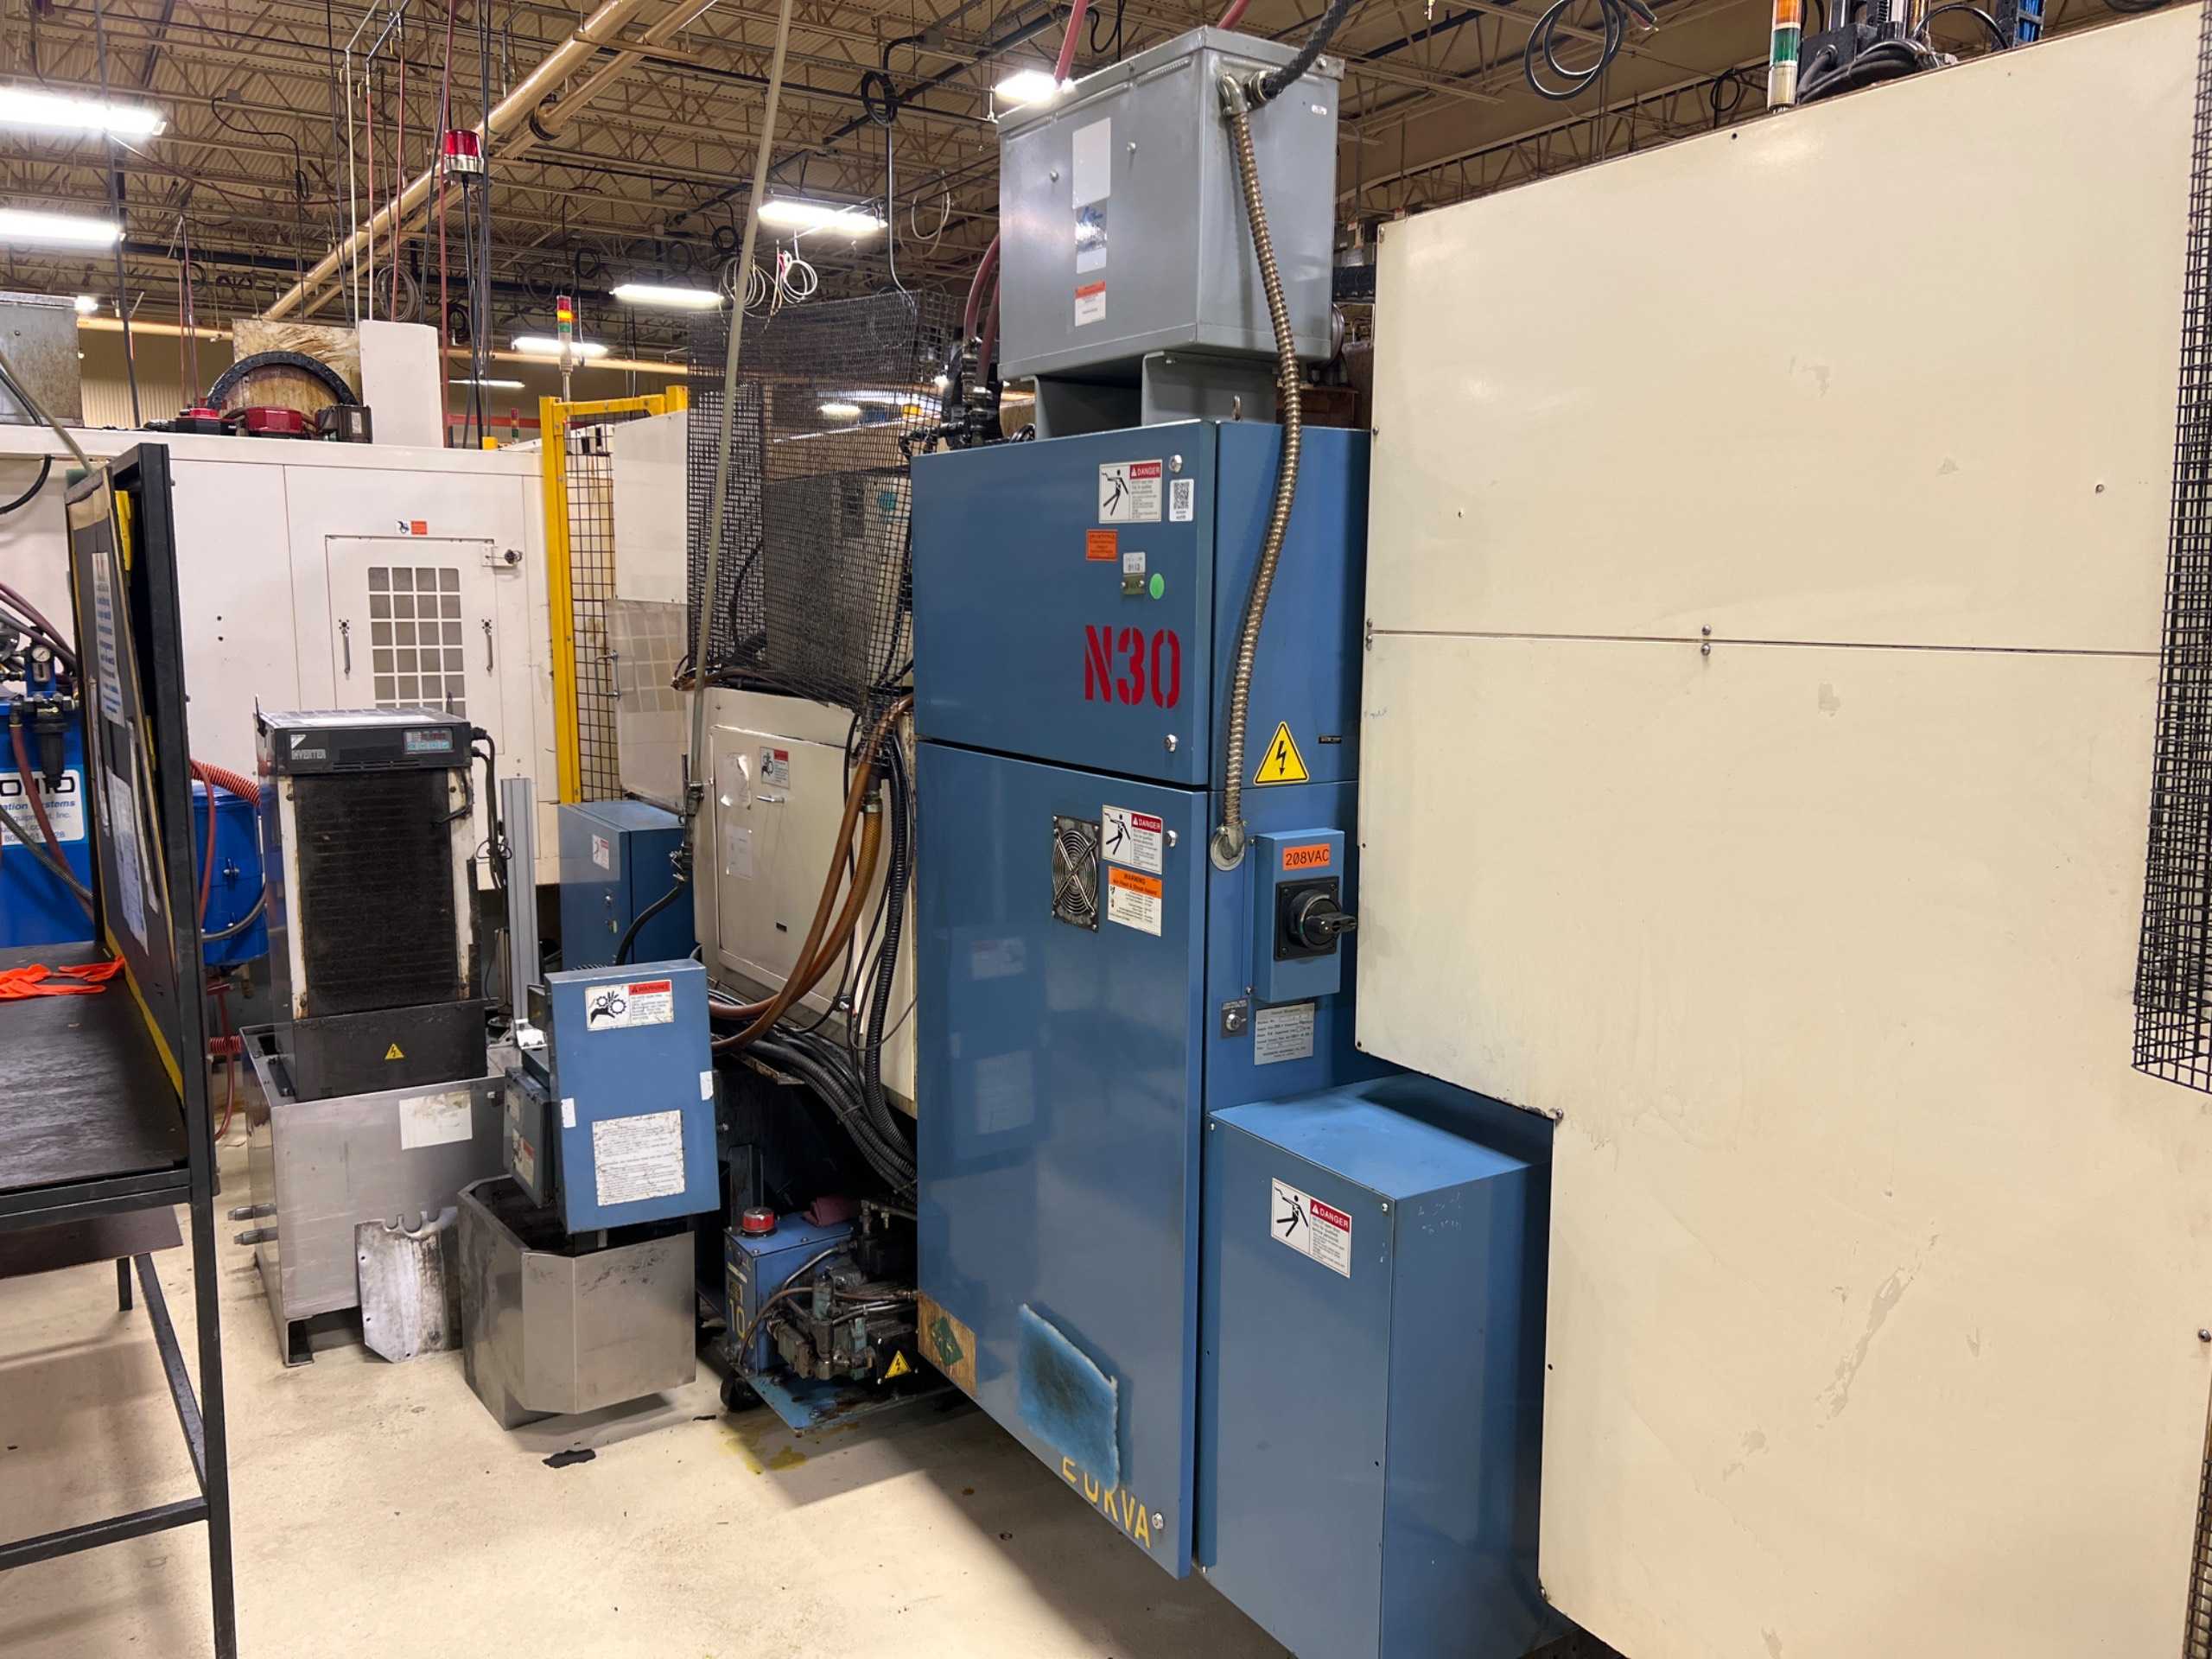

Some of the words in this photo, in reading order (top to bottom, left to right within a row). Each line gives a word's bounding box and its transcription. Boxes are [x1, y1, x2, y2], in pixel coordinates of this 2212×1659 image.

[1137, 467, 1160, 477] DANGER
[1084, 625, 1181, 709] N30
[291, 748, 327, 760] INVERTER
[1138, 817, 1161, 830] DANGER
[1285, 849, 1330, 866] 208VAC
[1319, 1207, 1349, 1228] DANGER
